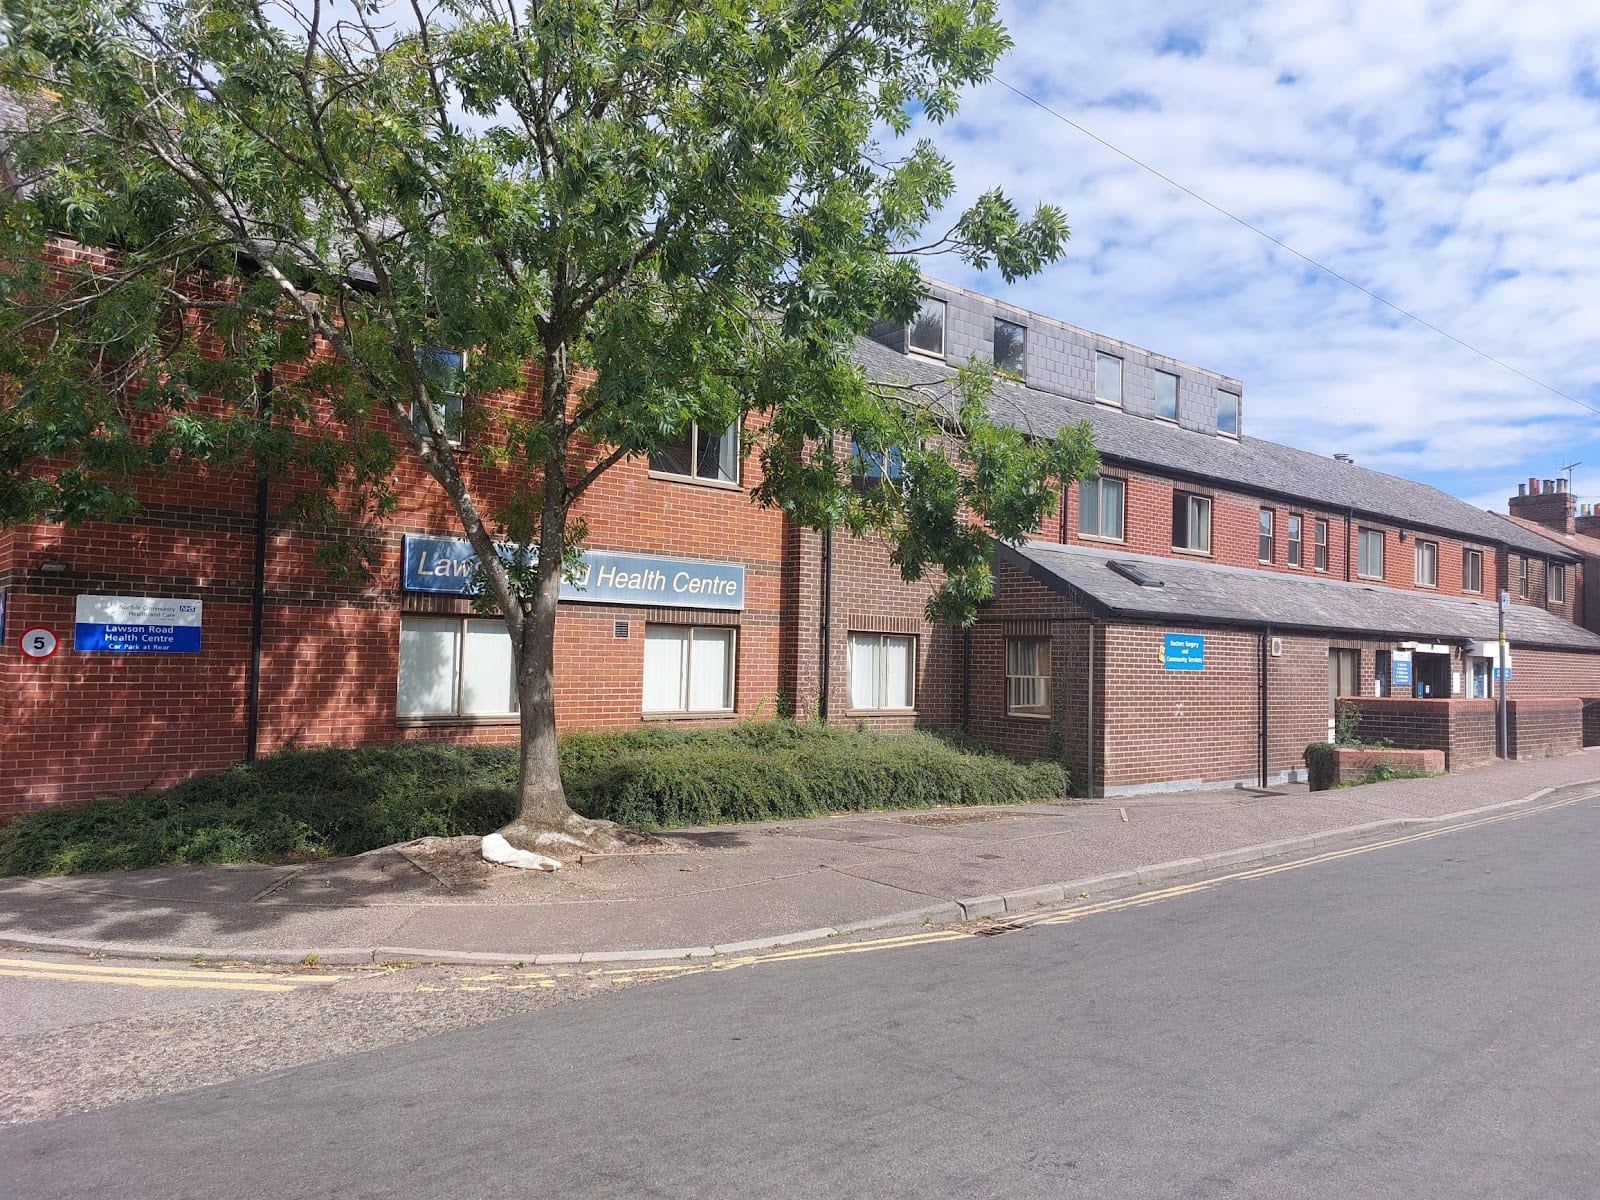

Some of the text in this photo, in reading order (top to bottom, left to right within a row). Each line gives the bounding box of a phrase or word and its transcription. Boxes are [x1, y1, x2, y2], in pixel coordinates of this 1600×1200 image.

[597, 565, 666, 591] Health
[673, 572, 737, 596] Centre
[143, 605, 176, 613] Community
[180, 605, 196, 613] NHS
[106, 625, 174, 634] Lawson Road
[105, 633, 174, 643] Health Centre
[34, 637, 45, 650] 5
